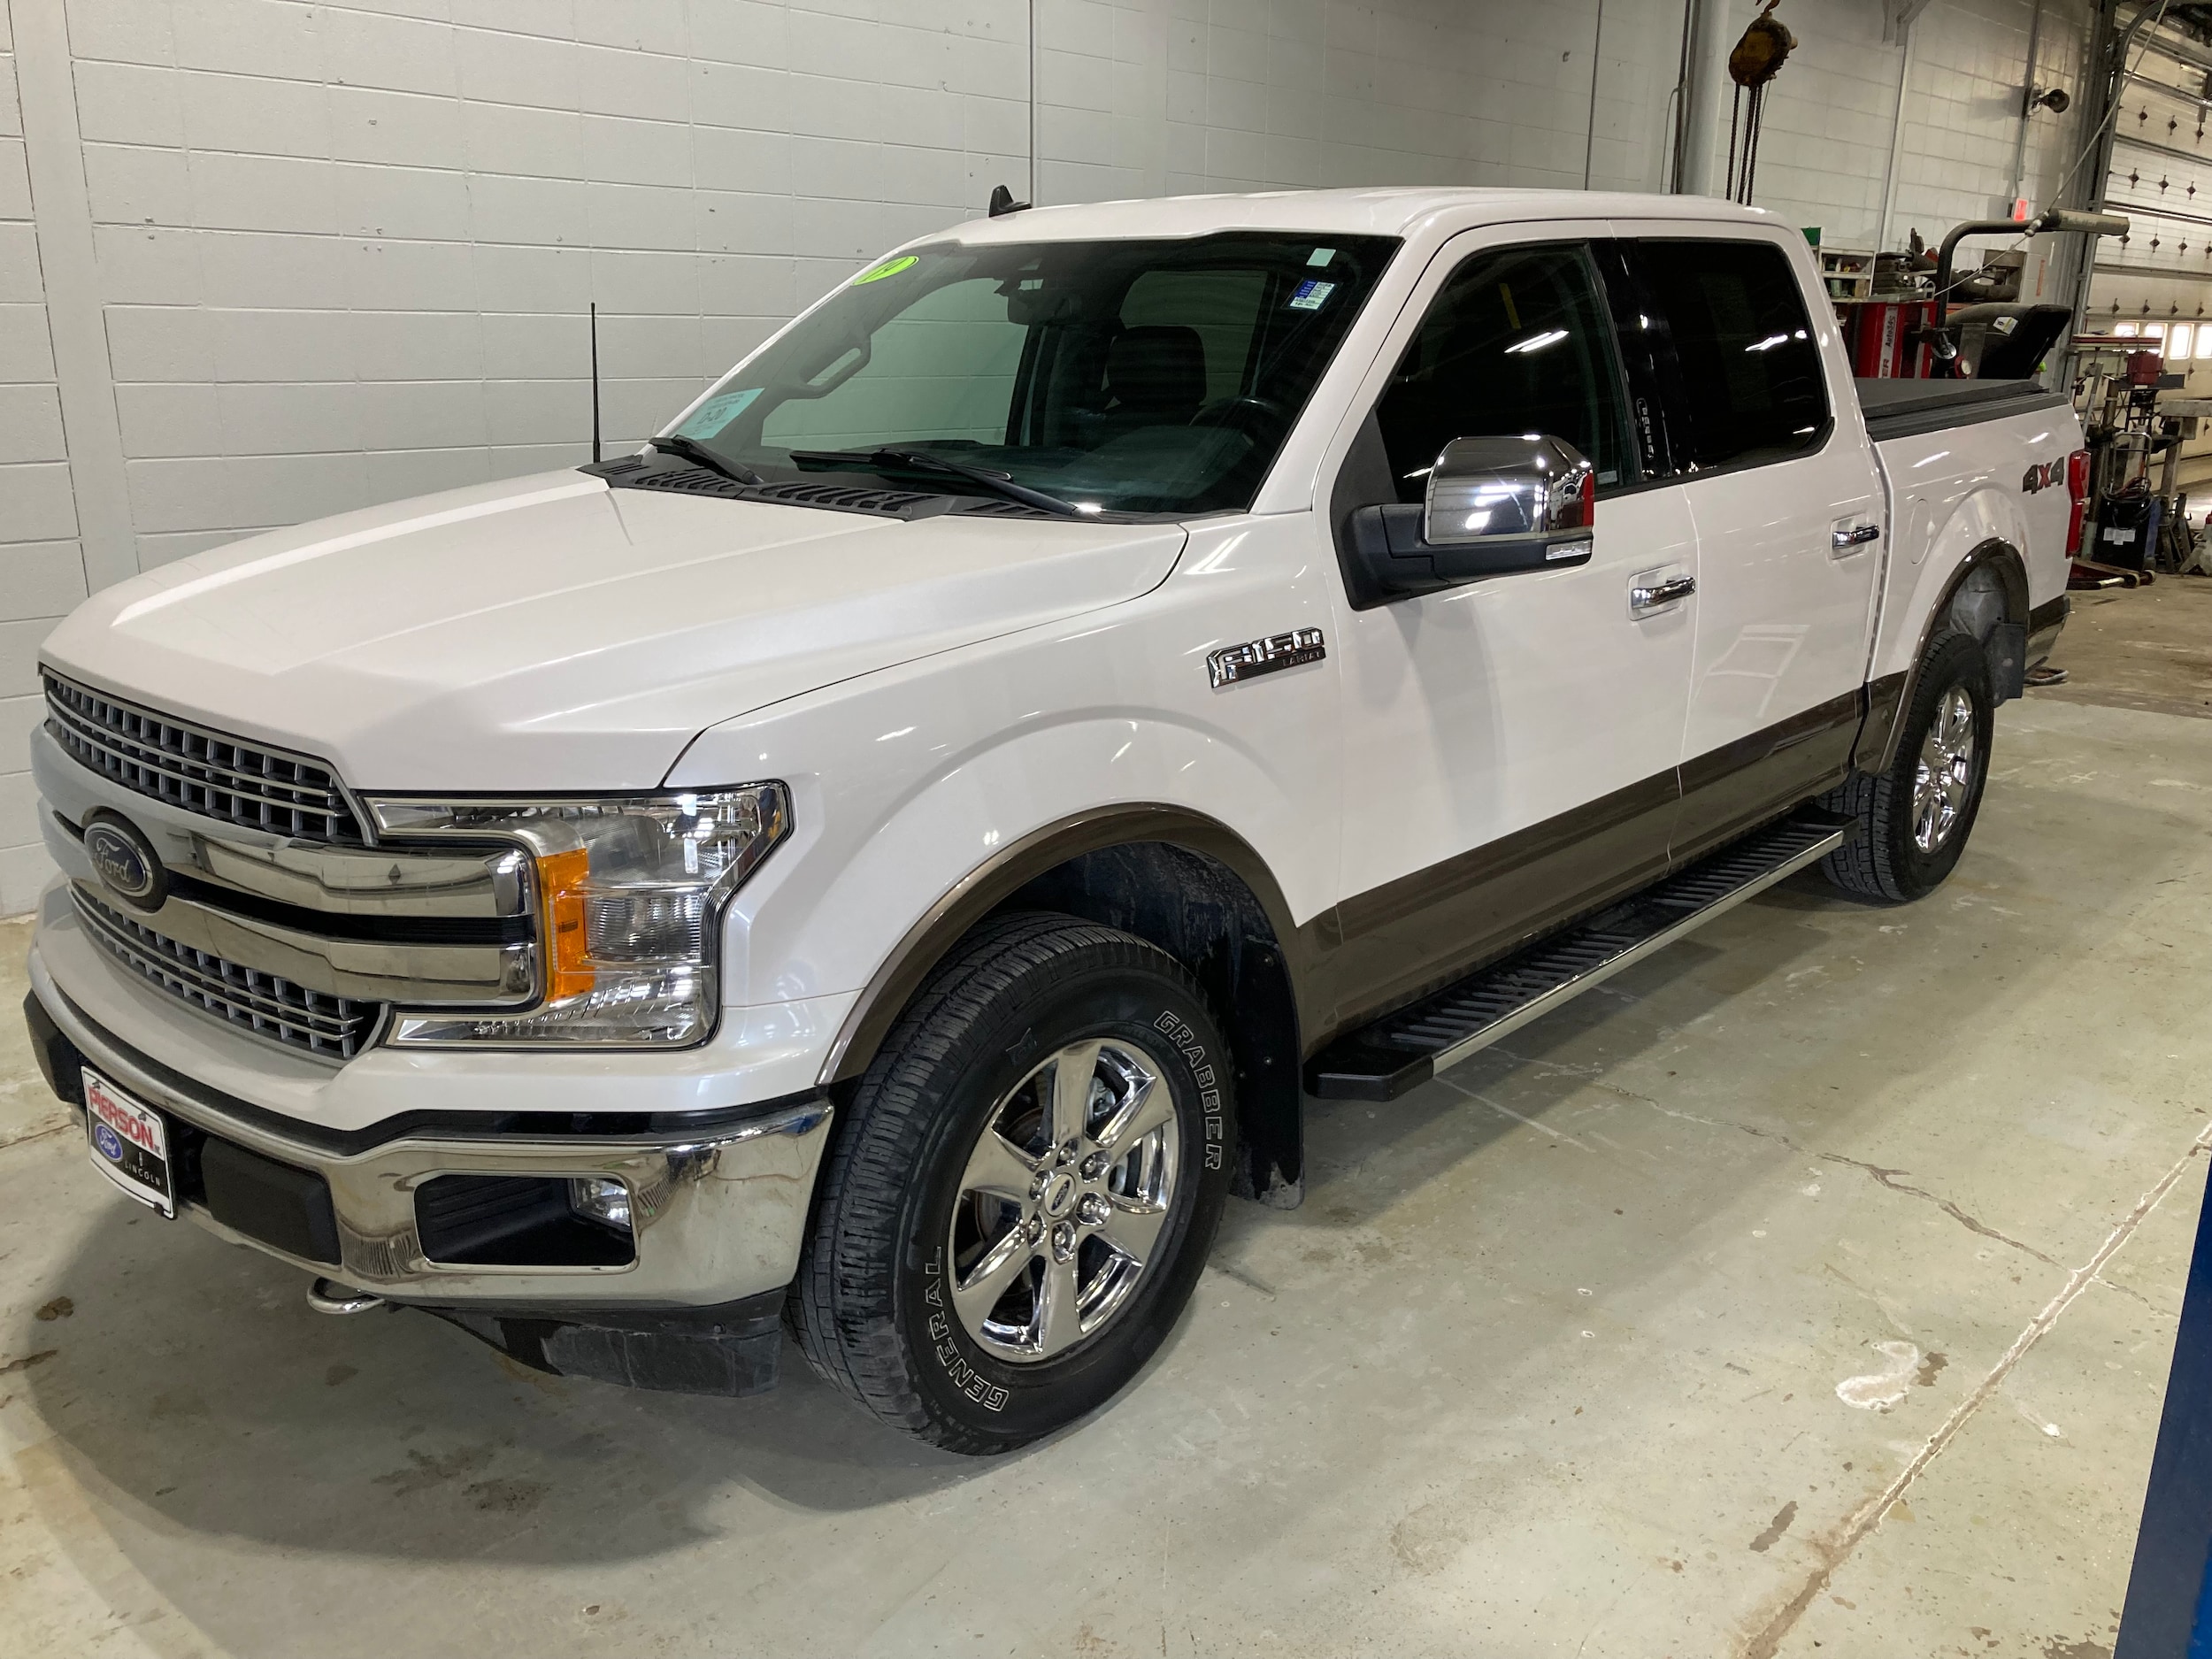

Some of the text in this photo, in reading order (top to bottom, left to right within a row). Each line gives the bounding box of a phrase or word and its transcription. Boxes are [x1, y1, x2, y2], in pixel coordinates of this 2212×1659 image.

[1282, 650, 1323, 667] LARIAT
[92, 836, 132, 883] Ford
[1153, 1010, 1223, 1170] GRABBER
[88, 1086, 154, 1151] PIERSON
[99, 1126, 118, 1156] Ford
[125, 1161, 161, 1187] LINCOLN
[925, 1246, 1010, 1412] GENERAL
